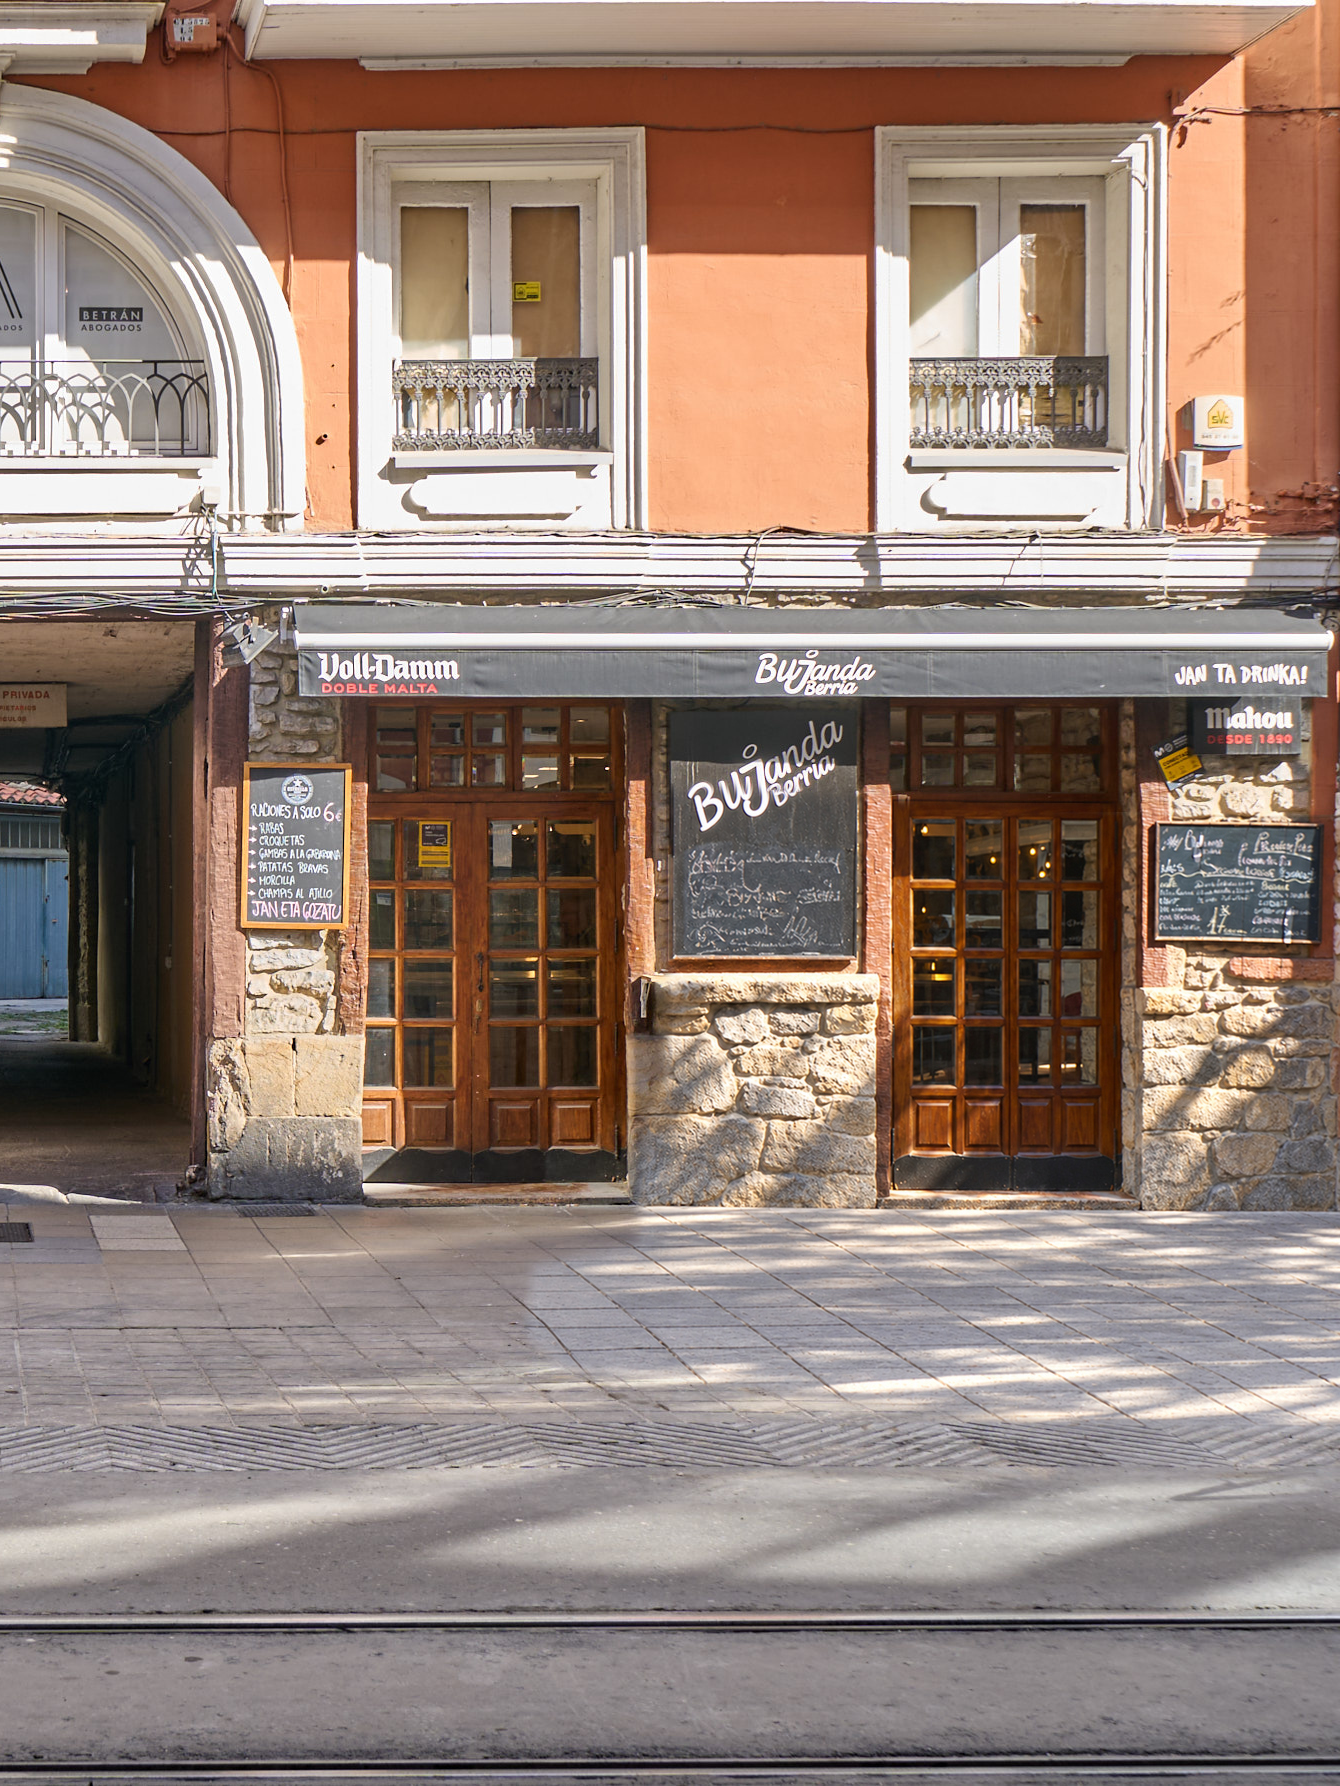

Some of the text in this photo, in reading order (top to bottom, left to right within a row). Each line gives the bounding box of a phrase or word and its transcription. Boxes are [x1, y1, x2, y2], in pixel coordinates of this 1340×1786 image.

[82, 308, 141, 322] BETRÁN
[81, 324, 142, 332] ABOGADOS
[317, 652, 460, 682] Voll-Damm
[1174, 663, 1308, 685] JAN TA DRINKA!
[321, 683, 438, 694] DOBLE MALTA
[804, 680, 858, 696] Berria
[2, 690, 50, 699] PRIVADA
[1207, 734, 1293, 744] DESDE 1890
[766, 755, 835, 807] Berria
[250, 803, 291, 819] RACIONES
[292, 806, 298, 819] A
[300, 806, 321, 819] SOLO
[259, 822, 284, 834] RABAS
[258, 835, 305, 846] CROQUETAS
[258, 848, 288, 860] GAMBAS
[289, 849, 295, 859] A
[296, 849, 305, 859] LA
[258, 861, 329, 873] PATATAS BRAVAS
[259, 874, 295, 886] MORCILLA
[258, 888, 333, 900] CHAMPIS AL AJILLO
[251, 901, 342, 921] JAN ETA GOZATU
